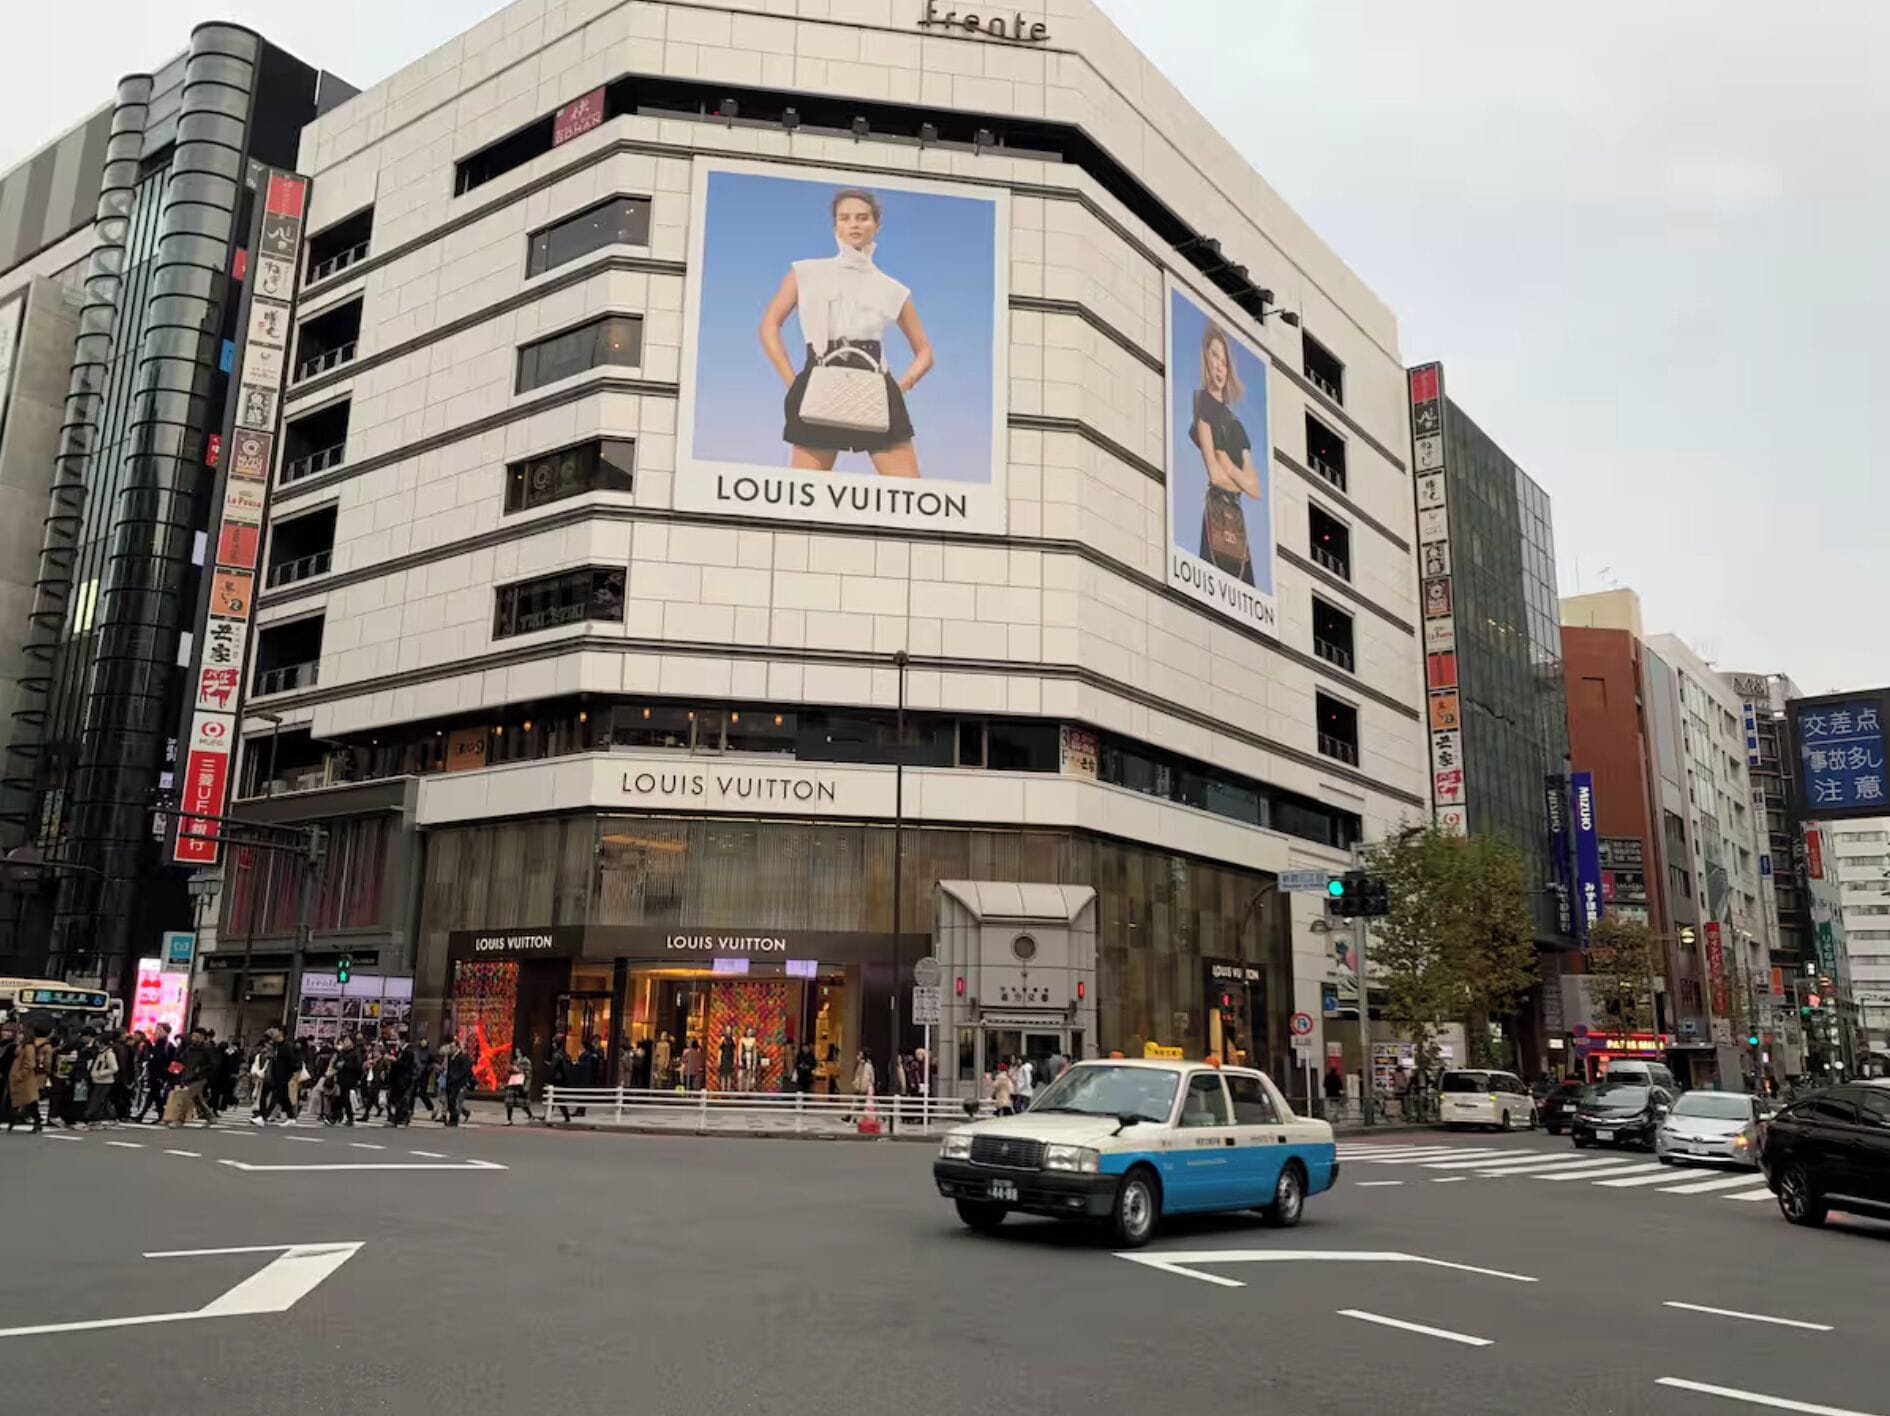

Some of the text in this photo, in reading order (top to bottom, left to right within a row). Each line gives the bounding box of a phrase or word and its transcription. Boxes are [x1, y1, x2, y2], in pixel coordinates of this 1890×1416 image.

[917, 0, 1051, 42] frente
[717, 474, 967, 518] LOUIS VUITTON
[1173, 555, 1275, 627] LOUIS VUITTON
[1804, 707, 1880, 737] 交差点
[1810, 746, 1883, 772] 事故多し
[622, 772, 836, 801] LOUIS VUITTON
[1814, 775, 1883, 803] 注意
[1578, 786, 1592, 831] MIZUHO
[475, 936, 552, 951] LOUIS VUITTON
[667, 935, 787, 951] LOUIS VUITTON
